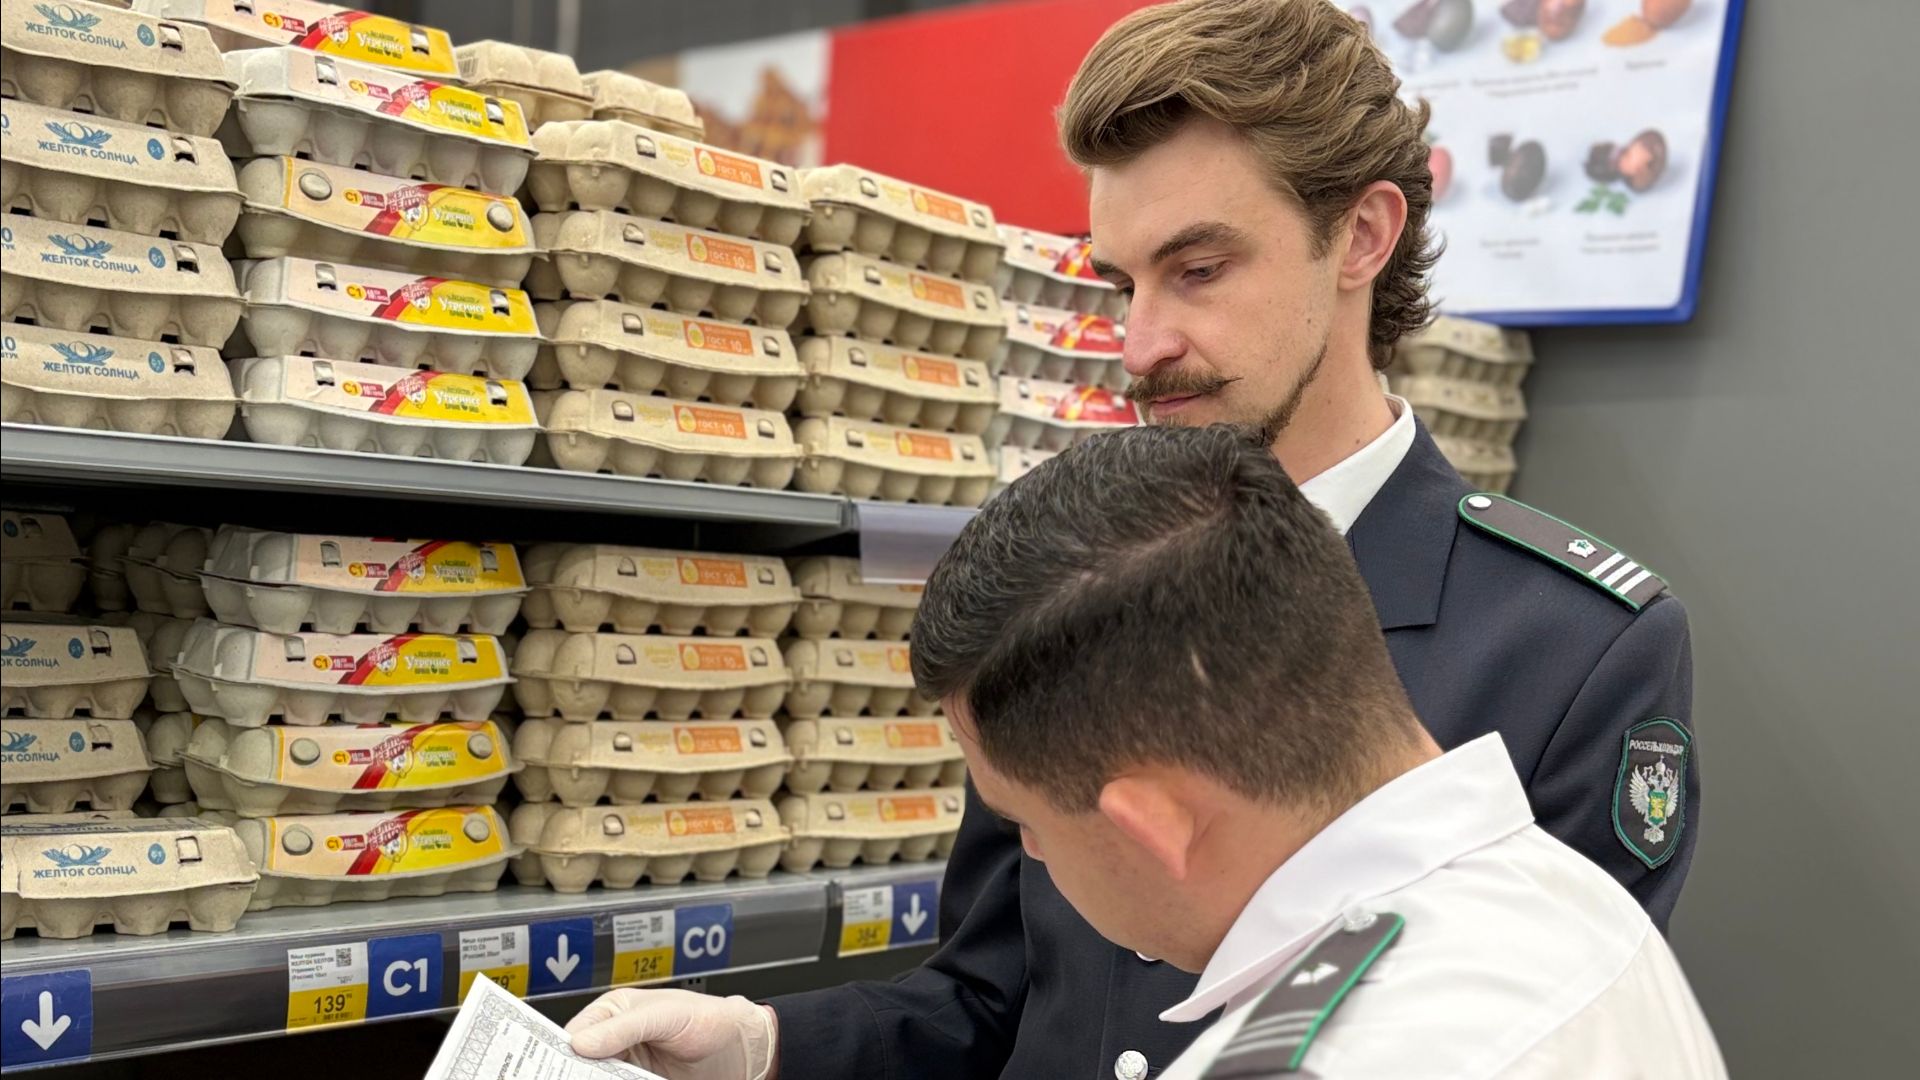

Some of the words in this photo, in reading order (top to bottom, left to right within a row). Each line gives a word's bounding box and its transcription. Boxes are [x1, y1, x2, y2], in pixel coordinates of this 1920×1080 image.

[25, 21, 77, 41] ЖЕЛТОК
[79, 32, 128, 50] СОЛНЦА
[38, 139, 88, 157] ЖЕЛТОК
[90, 148, 139, 165] СОЛНЦА
[40, 252, 90, 268] ЖЕЛТОК
[93, 259, 141, 274] СОЛНЦА
[43, 361, 91, 375] ЖЕЛТОК
[94, 366, 140, 380] СОЛНЦА
[15, 658, 60, 669] СОЛНЦА
[16, 752, 61, 763] СОЛНЦА
[33, 867, 84, 879] ЖЕЛТОК
[87, 865, 138, 877] СОЛНЦА
[682, 924, 727, 959] С0
[383, 958, 428, 997] С1
[314, 994, 346, 1014] 139
